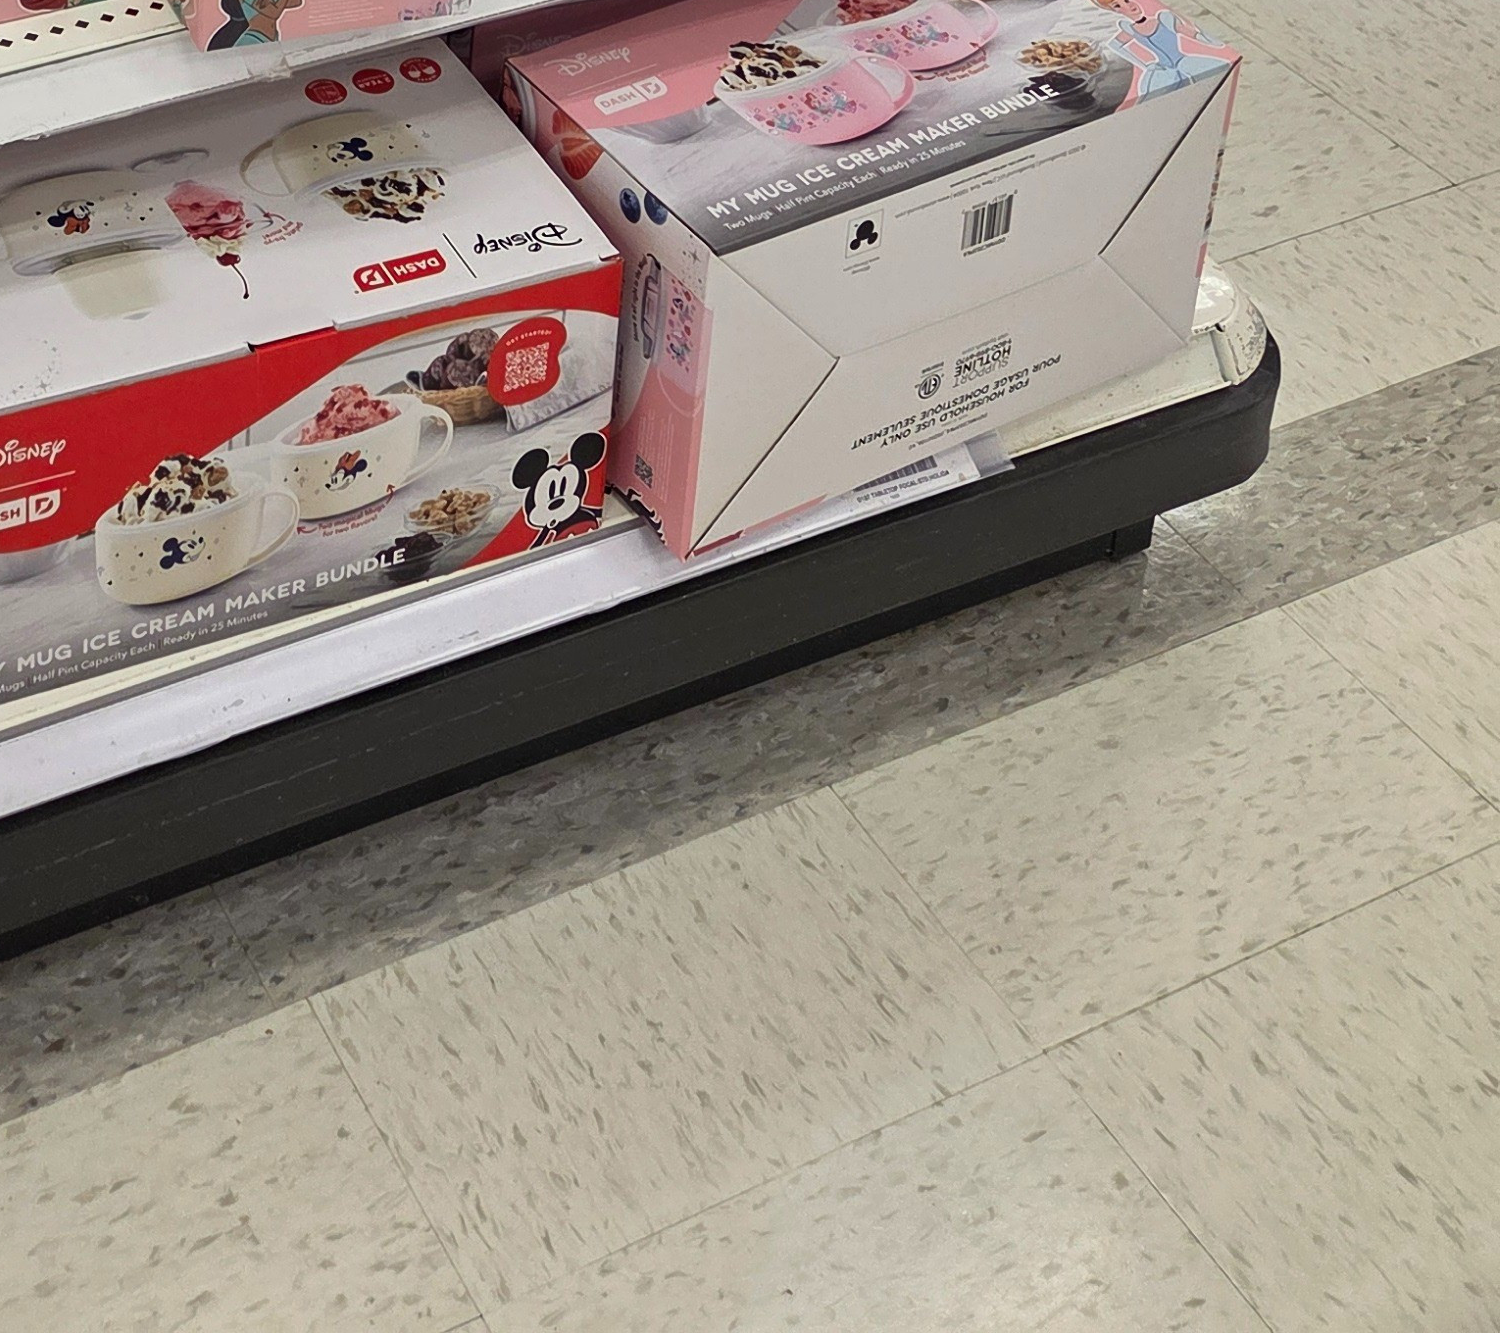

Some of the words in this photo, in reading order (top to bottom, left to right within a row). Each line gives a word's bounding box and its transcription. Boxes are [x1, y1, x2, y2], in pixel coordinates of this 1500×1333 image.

[543, 45, 631, 79] Disney
[599, 87, 636, 111] DASH
[707, 195, 738, 221] MY
[744, 175, 795, 207] MUG
[796, 157, 834, 189] ICE
[835, 137, 912, 173] CREAM
[909, 111, 980, 147] MAKER
[979, 83, 1060, 123] BUNDLE
[16, 642, 72, 675] MUG
[83, 629, 121, 656] ICE
[131, 603, 214, 639] CREAM
[225, 576, 306, 611] MAKER
[316, 548, 406, 586] BUNDLE
